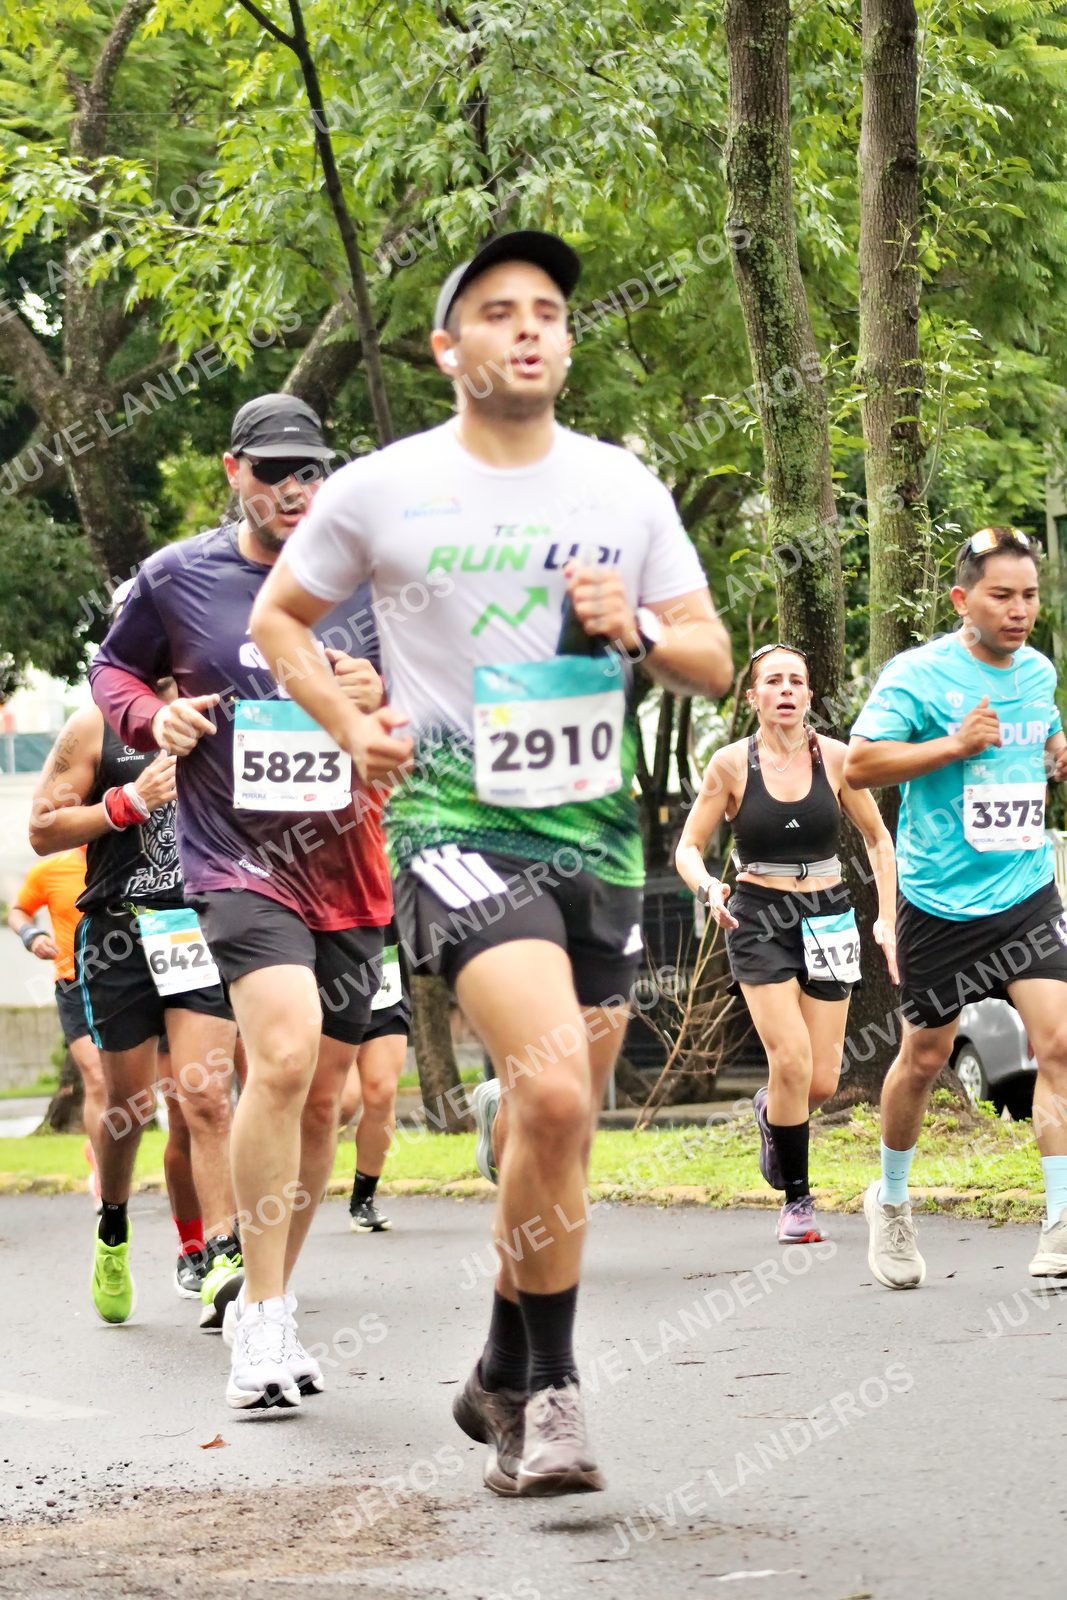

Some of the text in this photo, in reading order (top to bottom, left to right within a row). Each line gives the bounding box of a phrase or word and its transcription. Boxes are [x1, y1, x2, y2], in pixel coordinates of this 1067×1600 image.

[427, 543, 532, 574] RUN
[117, 754, 145, 763] TOPTIME
[489, 721, 613, 772] 2910
[241, 750, 341, 783] 5823
[972, 800, 1044, 829] 3373
[149, 943, 214, 975] 642
